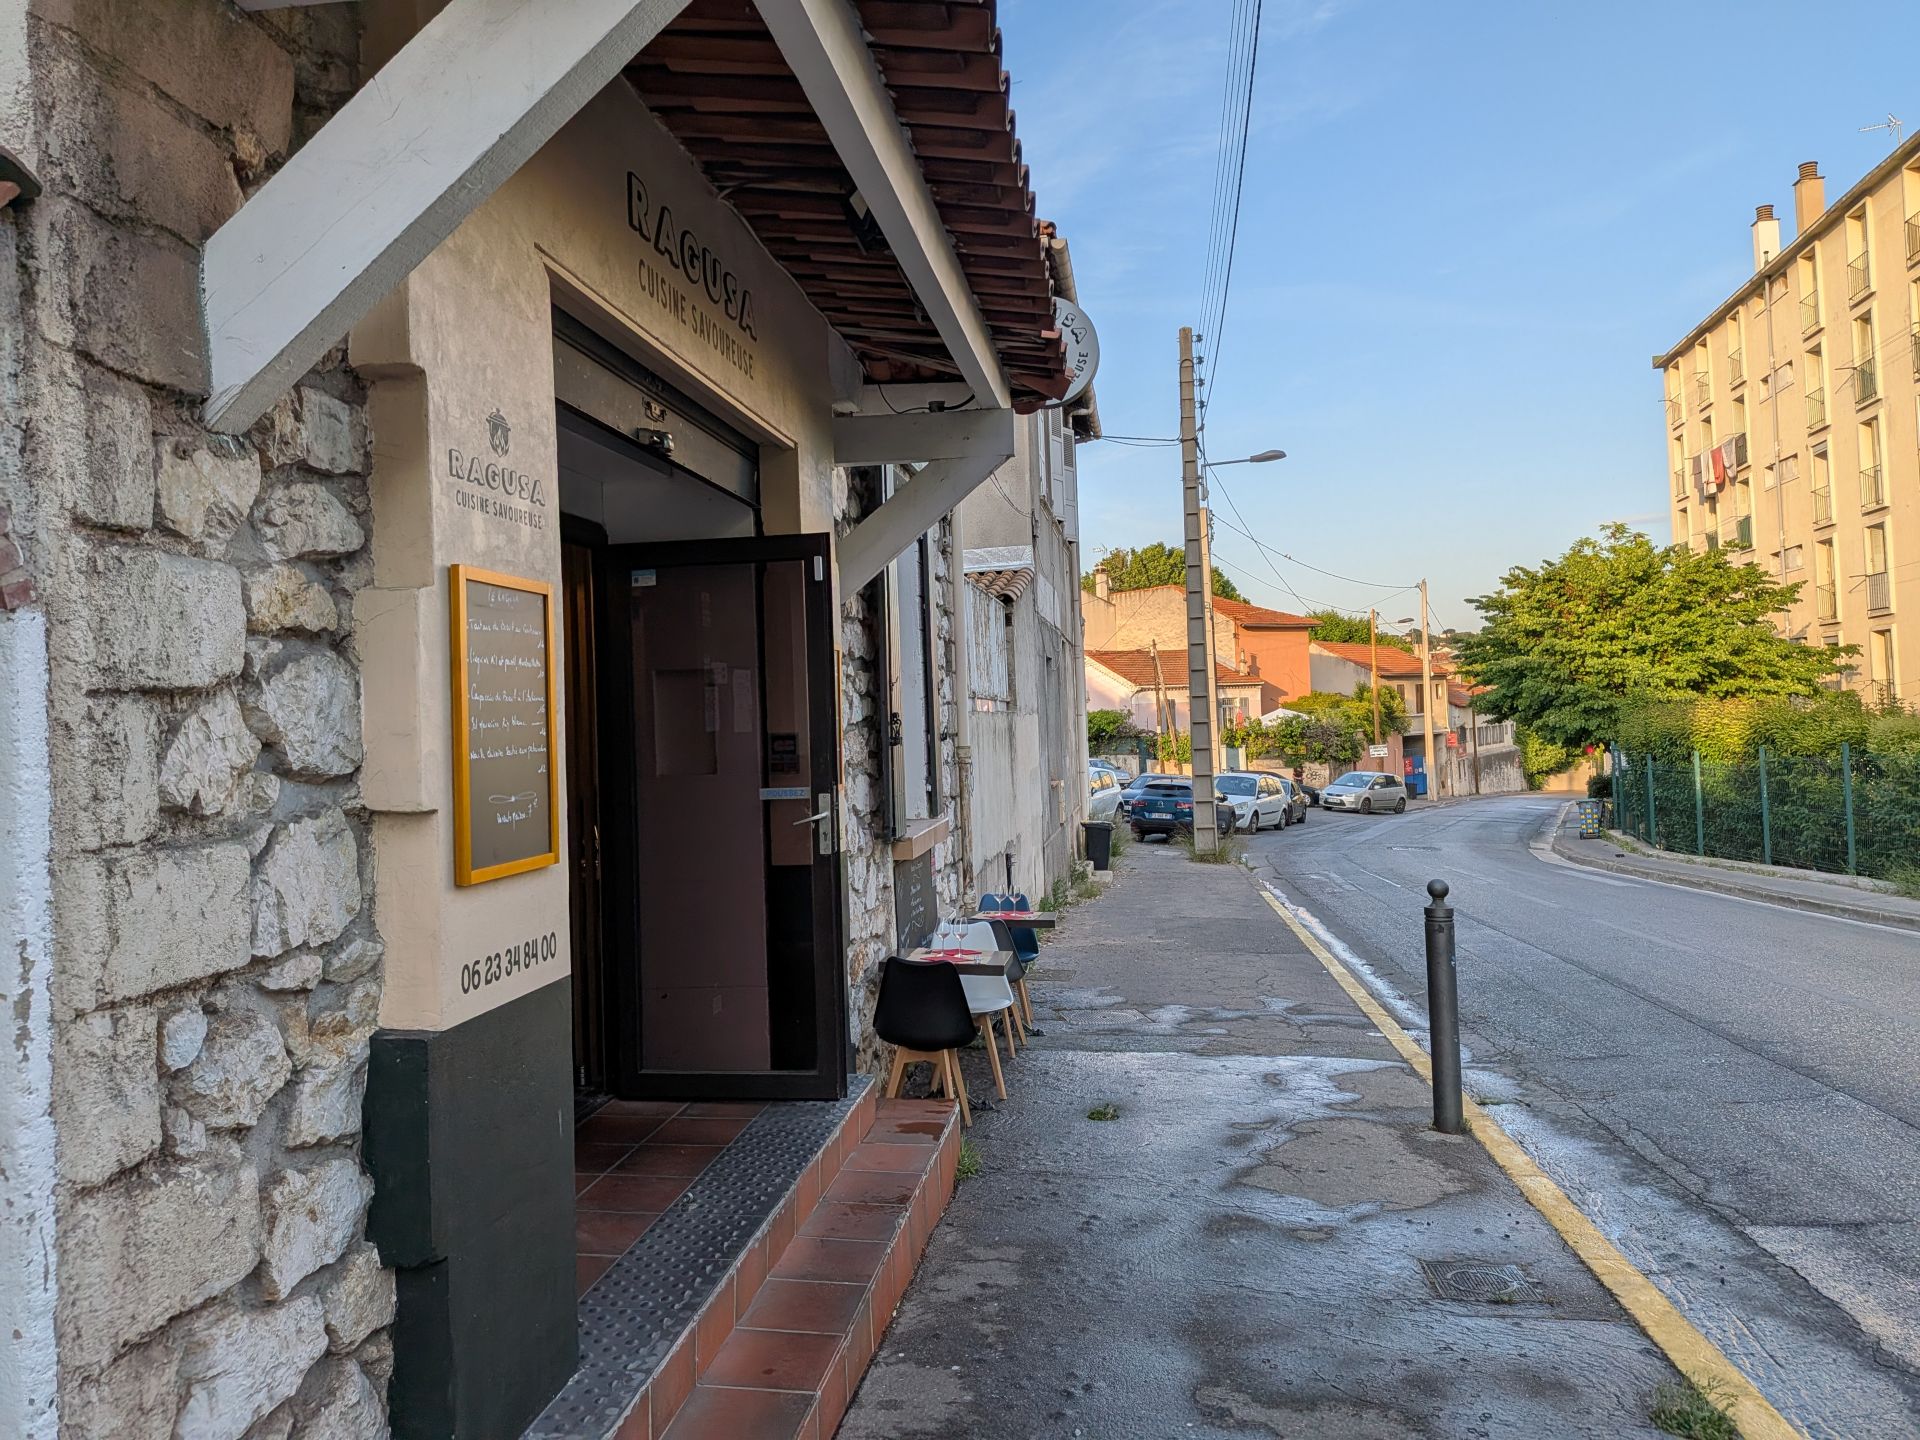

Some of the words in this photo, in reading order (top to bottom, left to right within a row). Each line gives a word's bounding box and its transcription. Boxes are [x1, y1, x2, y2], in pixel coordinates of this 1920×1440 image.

[626, 170, 758, 343] RAGUSA
[638, 258, 687, 326] CUISINE
[691, 304, 754, 380] SAVOUREUSE
[448, 448, 546, 508] RAGUSA
[455, 489, 490, 514] CUISINE
[492, 500, 542, 530] SAVOUREUSE
[767, 789, 805, 797] POUSSEZ
[461, 959, 481, 994] 06
[484, 952, 502, 985] 23
[505, 945, 521, 977] 34
[523, 938, 539, 969] 84
[541, 931, 557, 963] 00
